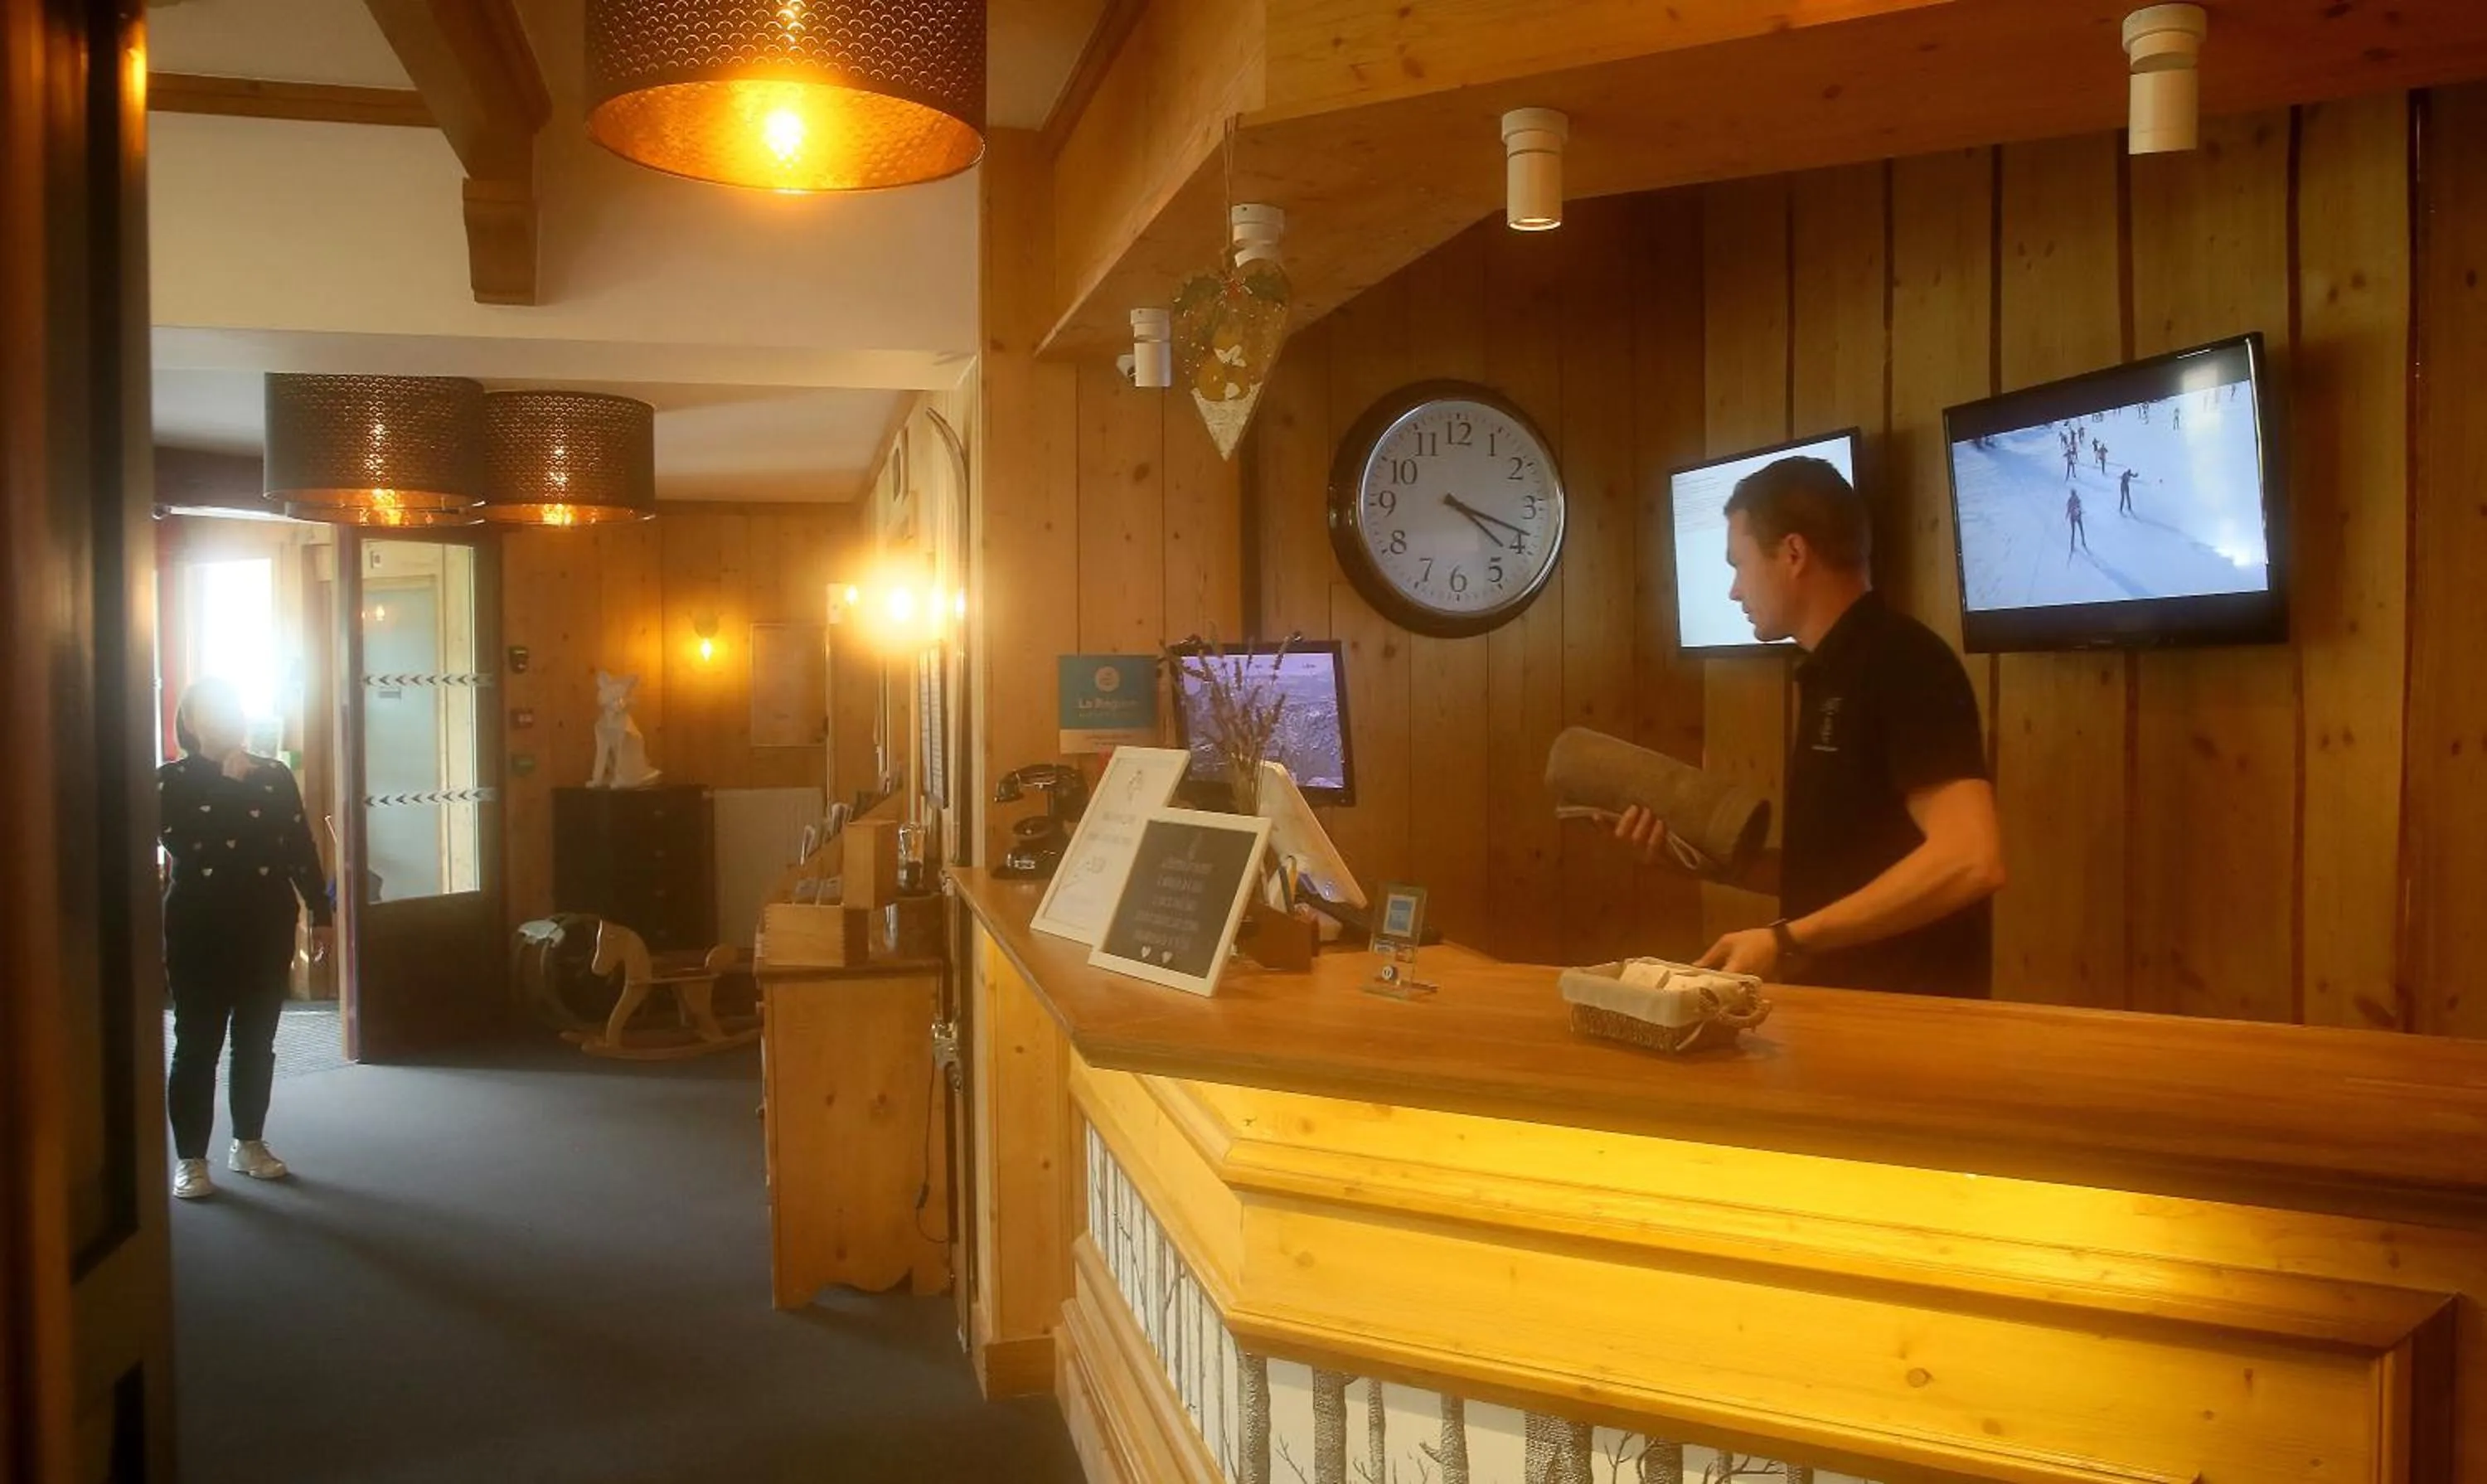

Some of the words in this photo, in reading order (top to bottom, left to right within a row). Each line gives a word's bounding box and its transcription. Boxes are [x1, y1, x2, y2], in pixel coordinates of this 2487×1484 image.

[1415, 432, 1439, 457] 11
[1445, 421, 1472, 446] 12
[1488, 433, 1496, 457] 1
[1390, 458, 1418, 486] 10
[1507, 457, 1524, 480] 2
[1379, 490, 1397, 517] 9
[1523, 495, 1537, 520] 3
[1390, 530, 1408, 555] 8
[1509, 531, 1525, 555] 4
[1418, 557, 1434, 584] 7
[1450, 565, 1468, 593] 6
[1488, 557, 1502, 584] 5
